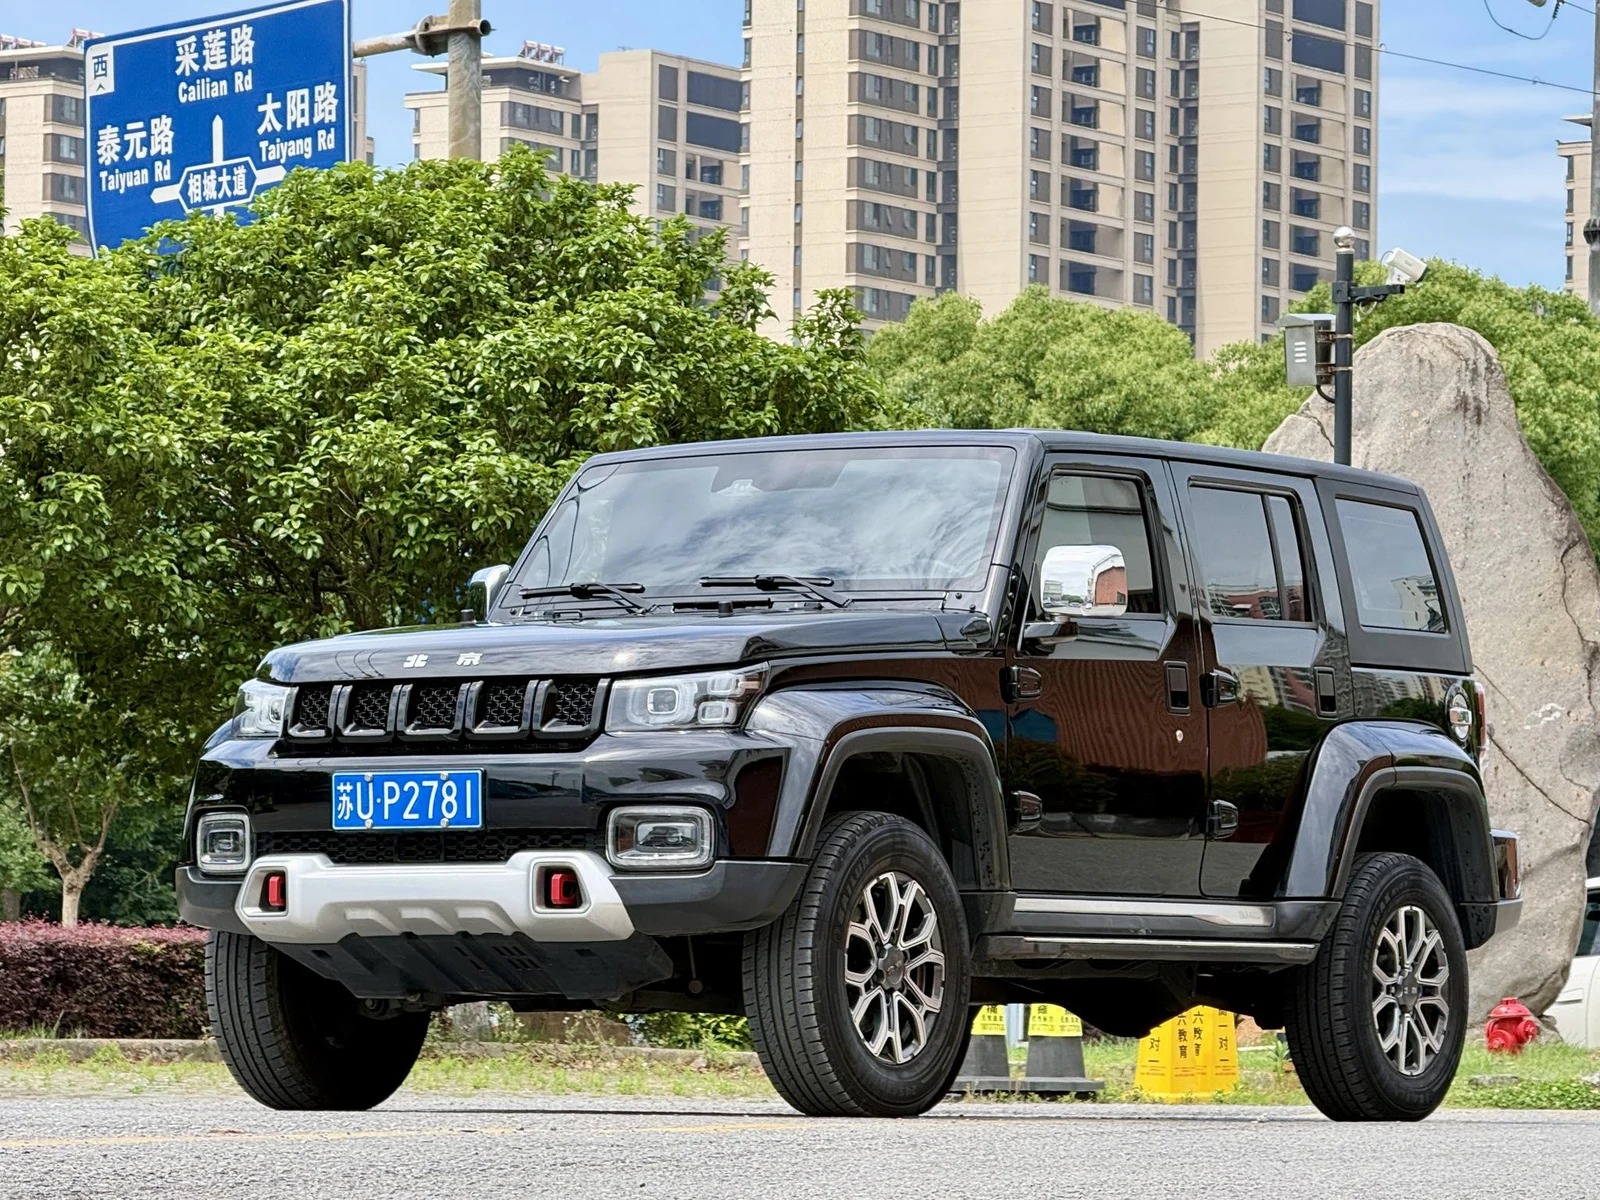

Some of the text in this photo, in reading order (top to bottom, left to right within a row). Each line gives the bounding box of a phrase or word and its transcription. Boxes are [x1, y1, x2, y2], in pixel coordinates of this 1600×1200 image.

[92, 53, 108, 80] 西
[175, 24, 255, 76] 采莲路
[178, 69, 253, 103] Cailian Rd
[257, 81, 339, 135] 太阳路
[97, 114, 174, 166] 泰元路
[259, 127, 335, 163] Taiyang Rd
[100, 159, 171, 194] Taiyuan Rd
[188, 165, 248, 204] 相城大道
